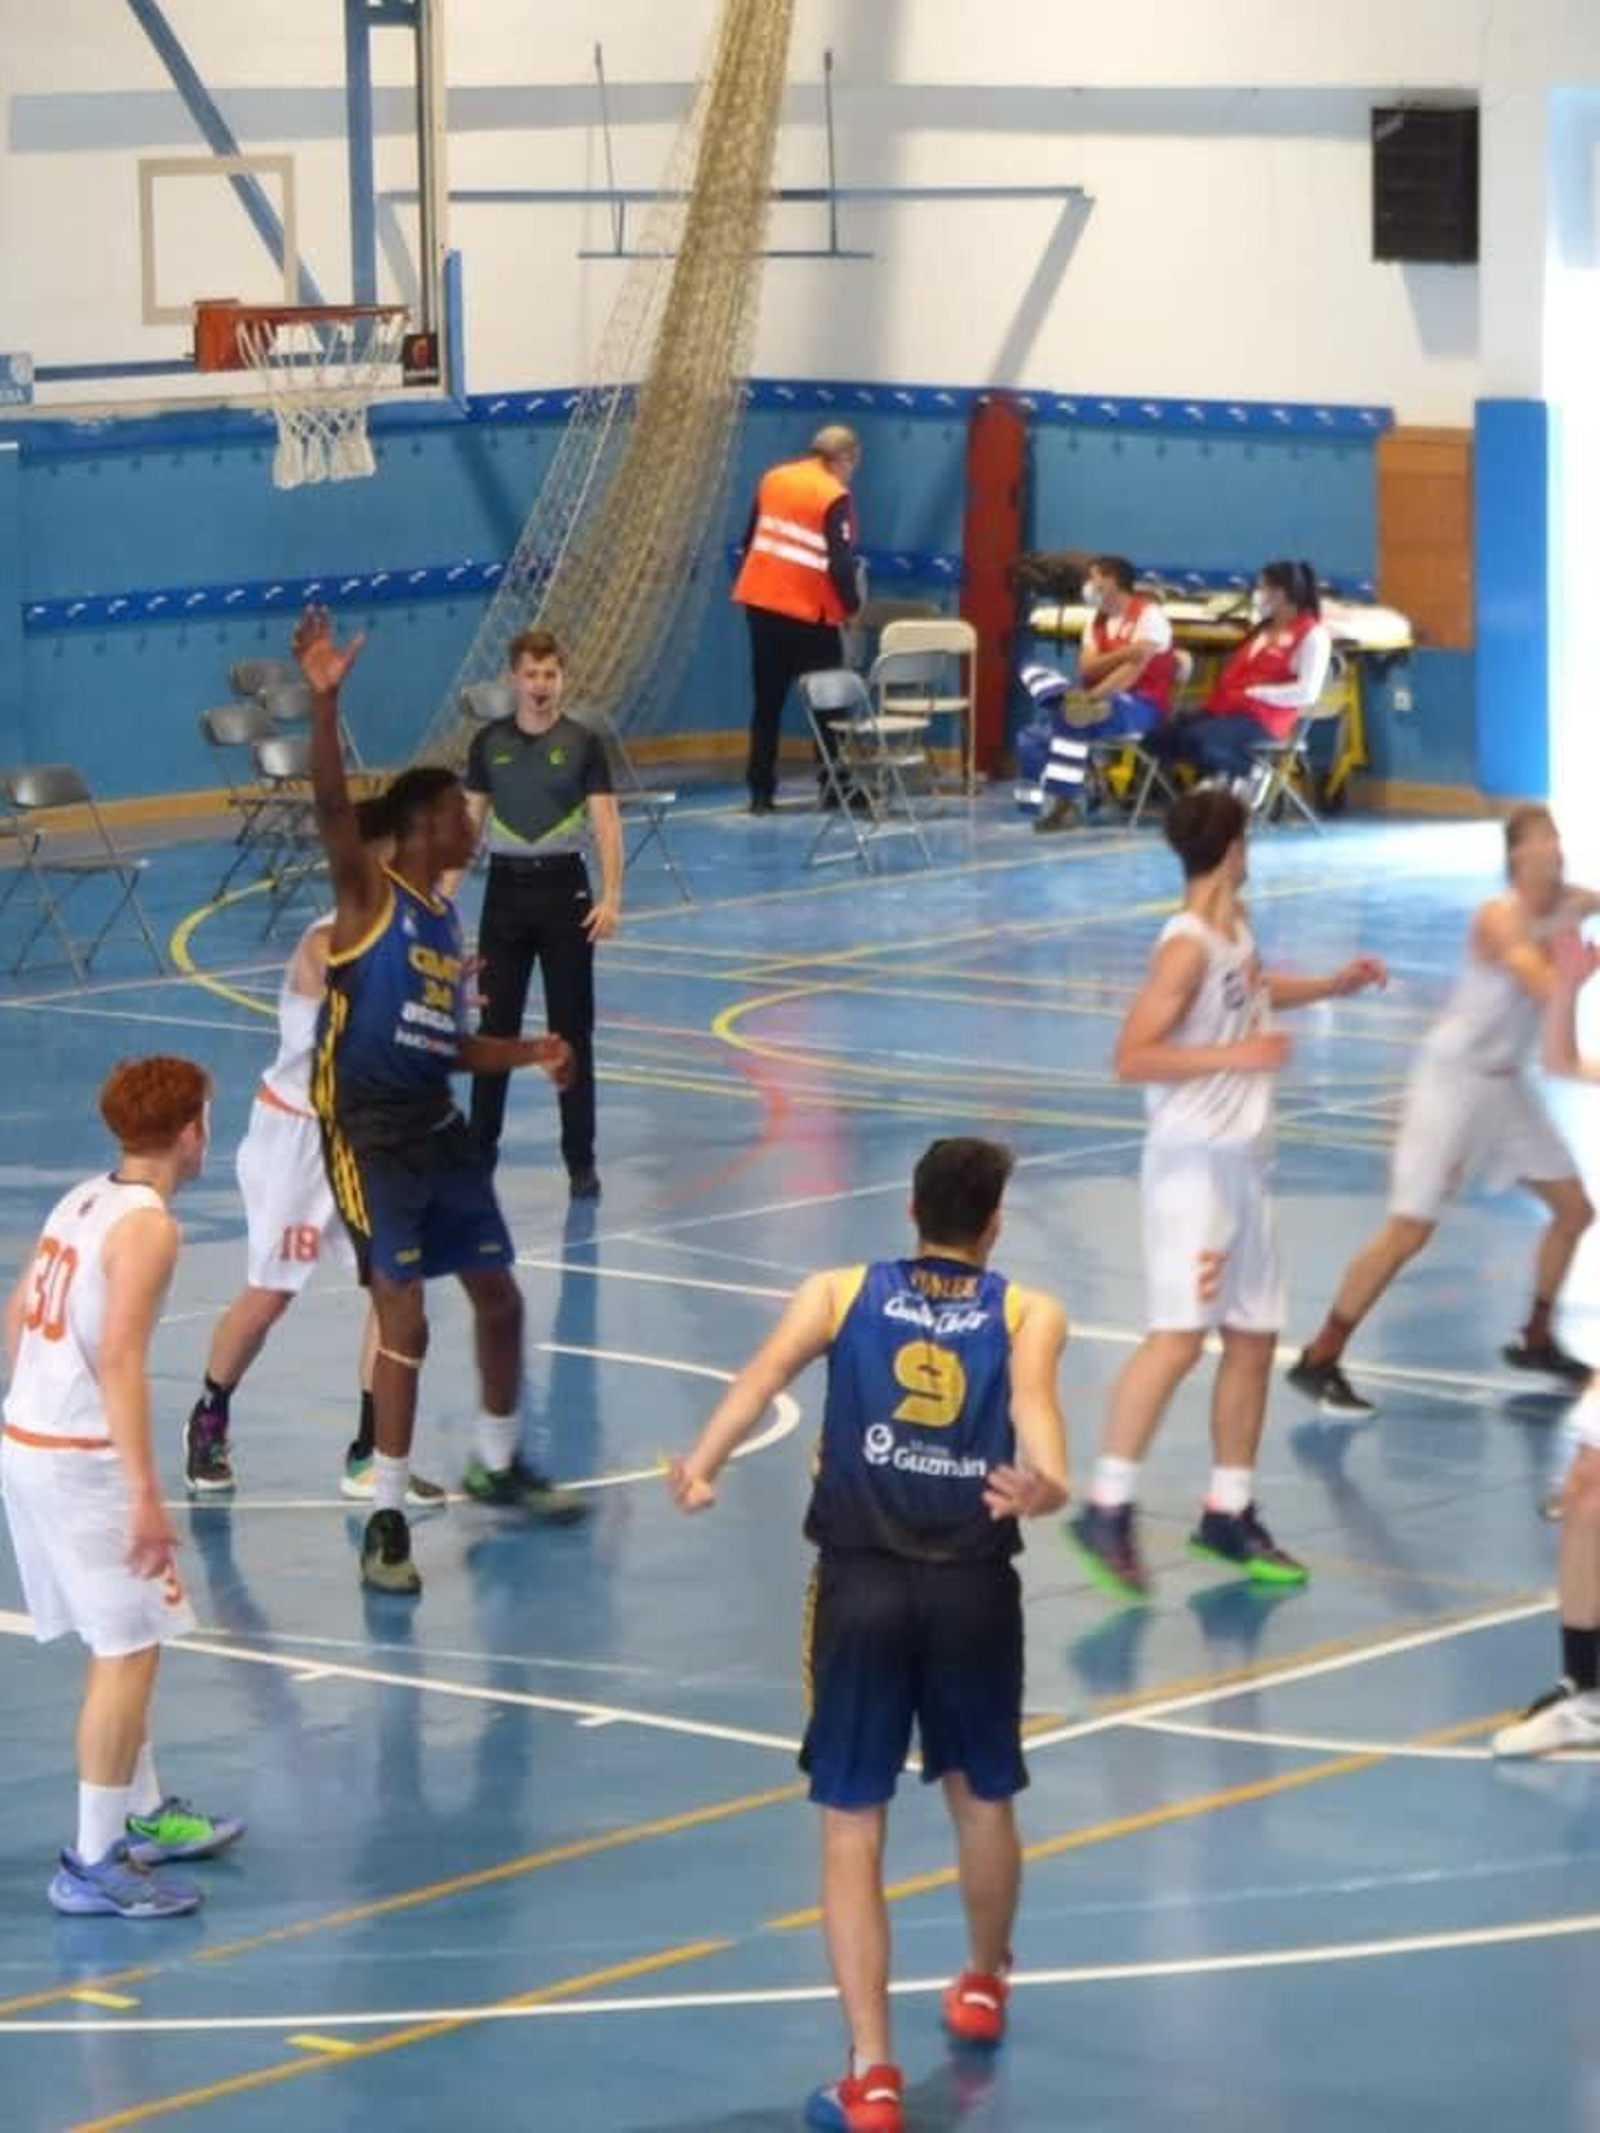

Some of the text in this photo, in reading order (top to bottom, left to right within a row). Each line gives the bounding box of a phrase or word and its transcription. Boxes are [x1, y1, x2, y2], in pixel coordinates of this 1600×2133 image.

[281, 1226, 320, 1261] 18
[26, 1236, 78, 1342] 30
[891, 1341, 966, 1427] 9
